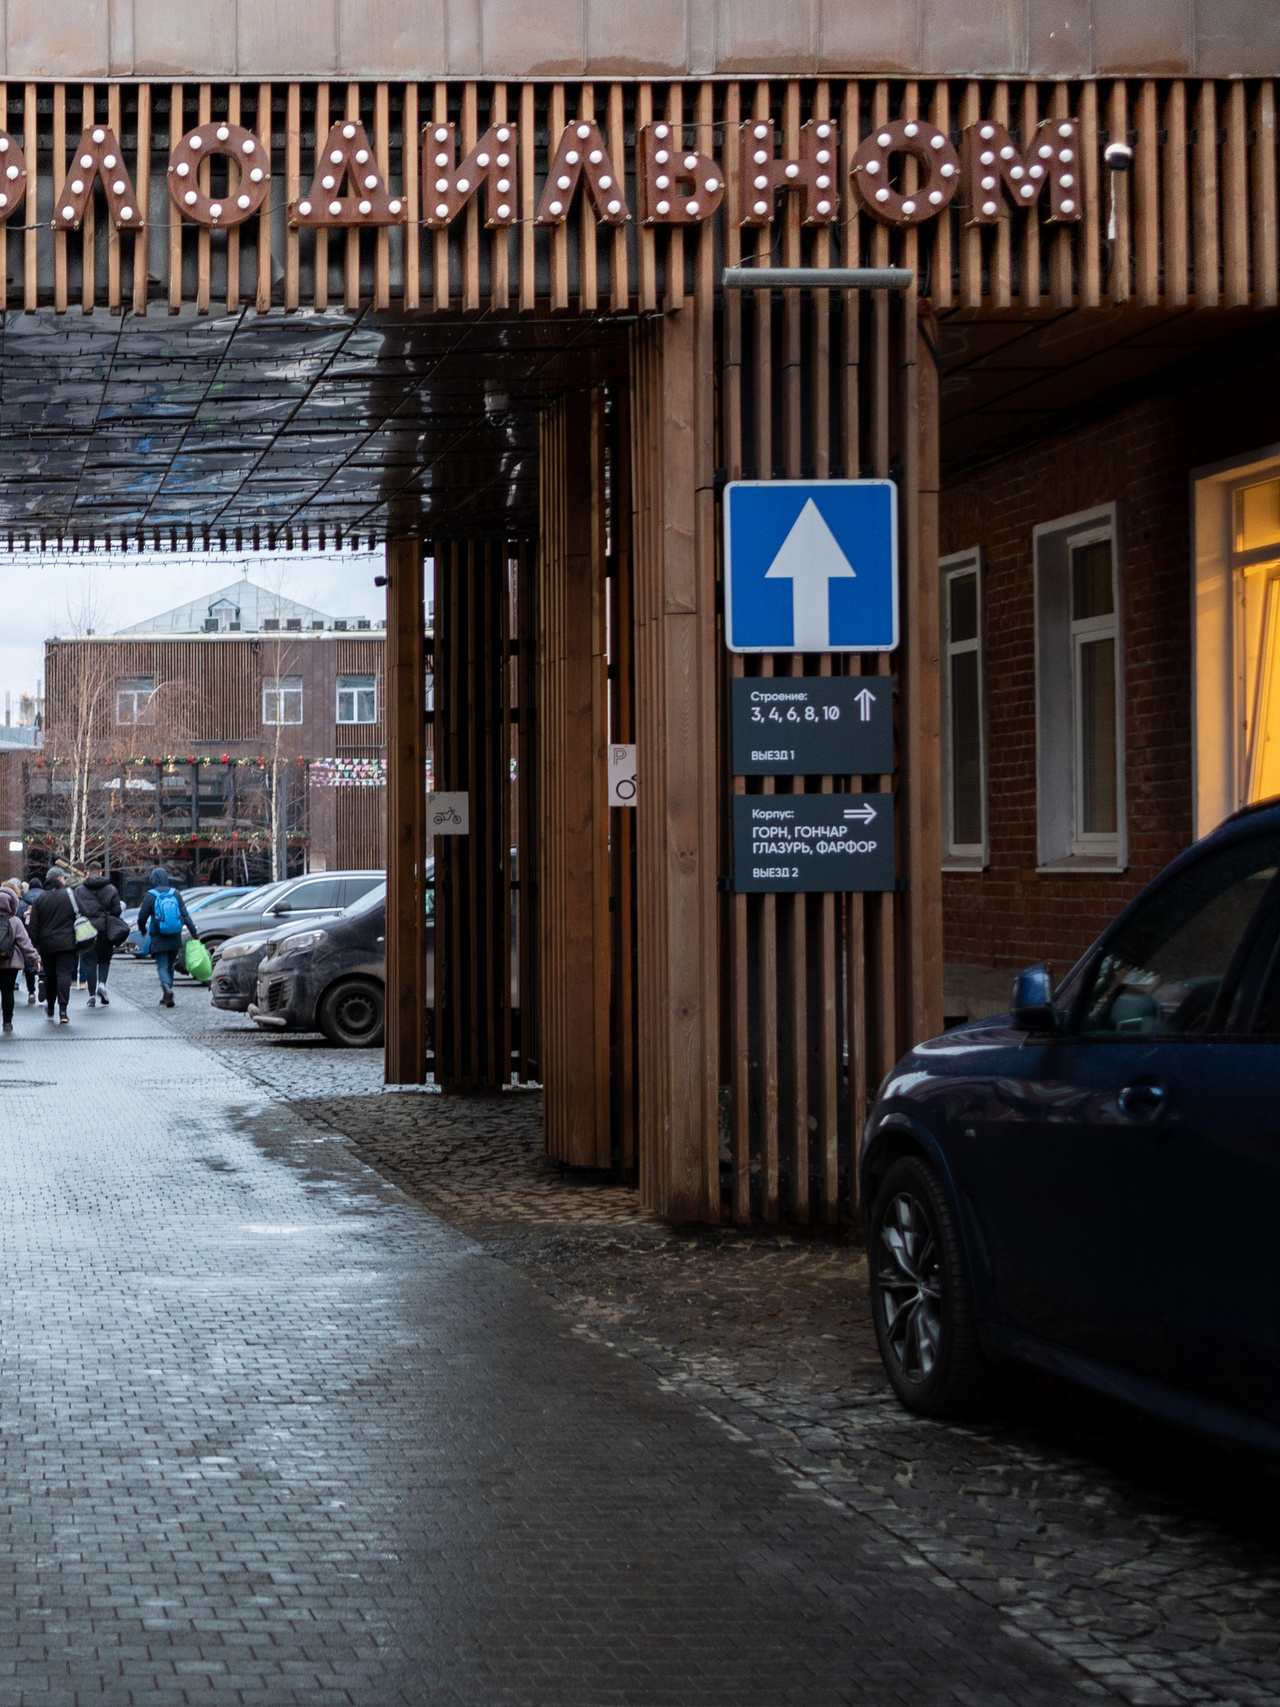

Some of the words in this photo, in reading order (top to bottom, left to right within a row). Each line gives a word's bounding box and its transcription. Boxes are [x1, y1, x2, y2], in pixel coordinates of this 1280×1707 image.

[750, 690, 808, 704] Строение:
[750, 706, 765, 724] 3,
[768, 706, 783, 724] 4,
[786, 706, 801, 723] 6,
[804, 705, 819, 723] 8,
[822, 705, 840, 721] 10
[751, 750, 789, 761] ВЫЕЗД
[790, 750, 795, 760] 1
[752, 808, 795, 821] Корпус:
[752, 826, 792, 840] ГОРН,
[794, 825, 848, 838] ГОНЧАР
[752, 841, 814, 855] ГЛАЗУРЬ,
[816, 840, 877, 855] ФАРФОР
[752, 867, 790, 878] ВЫЕЗД
[791, 867, 799, 878] 2
